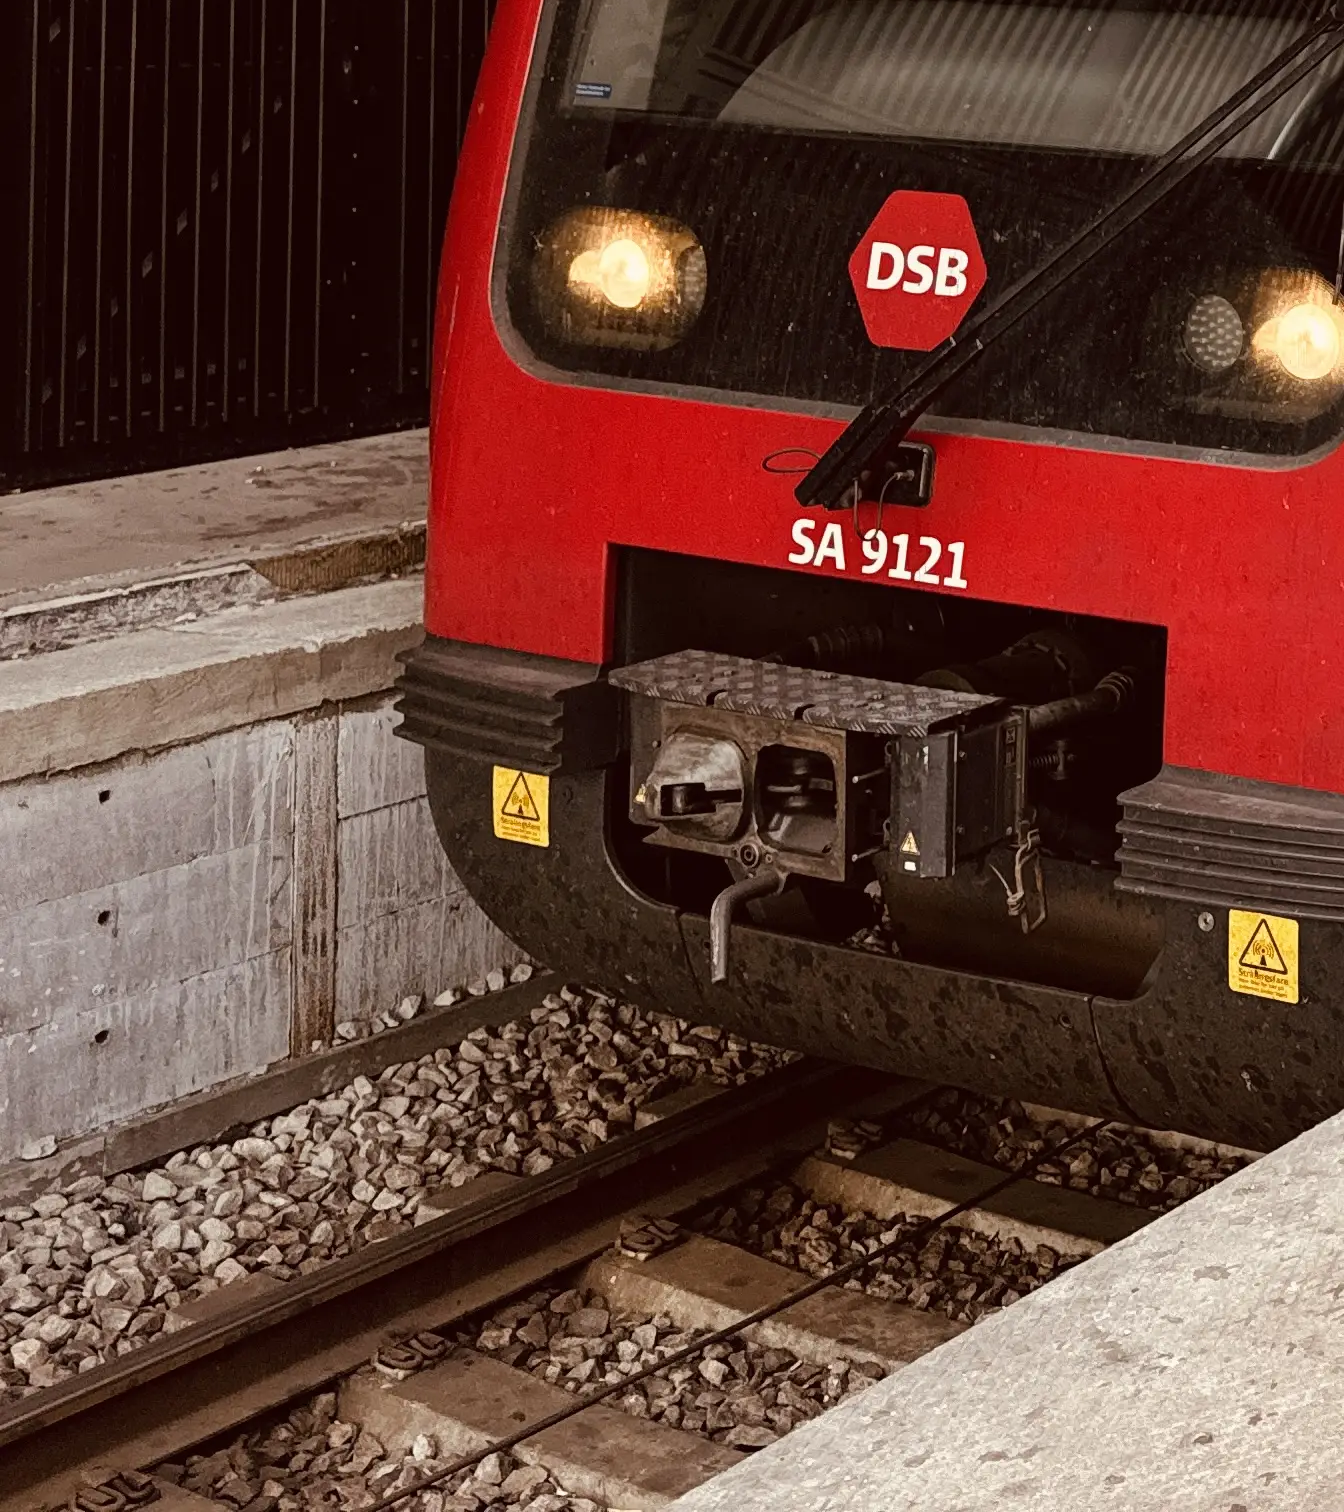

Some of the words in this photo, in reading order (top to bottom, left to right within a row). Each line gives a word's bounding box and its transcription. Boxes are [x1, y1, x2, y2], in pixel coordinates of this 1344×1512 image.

[866, 240, 969, 297] DSB
[788, 518, 846, 571] SA
[861, 528, 968, 589] 9121
